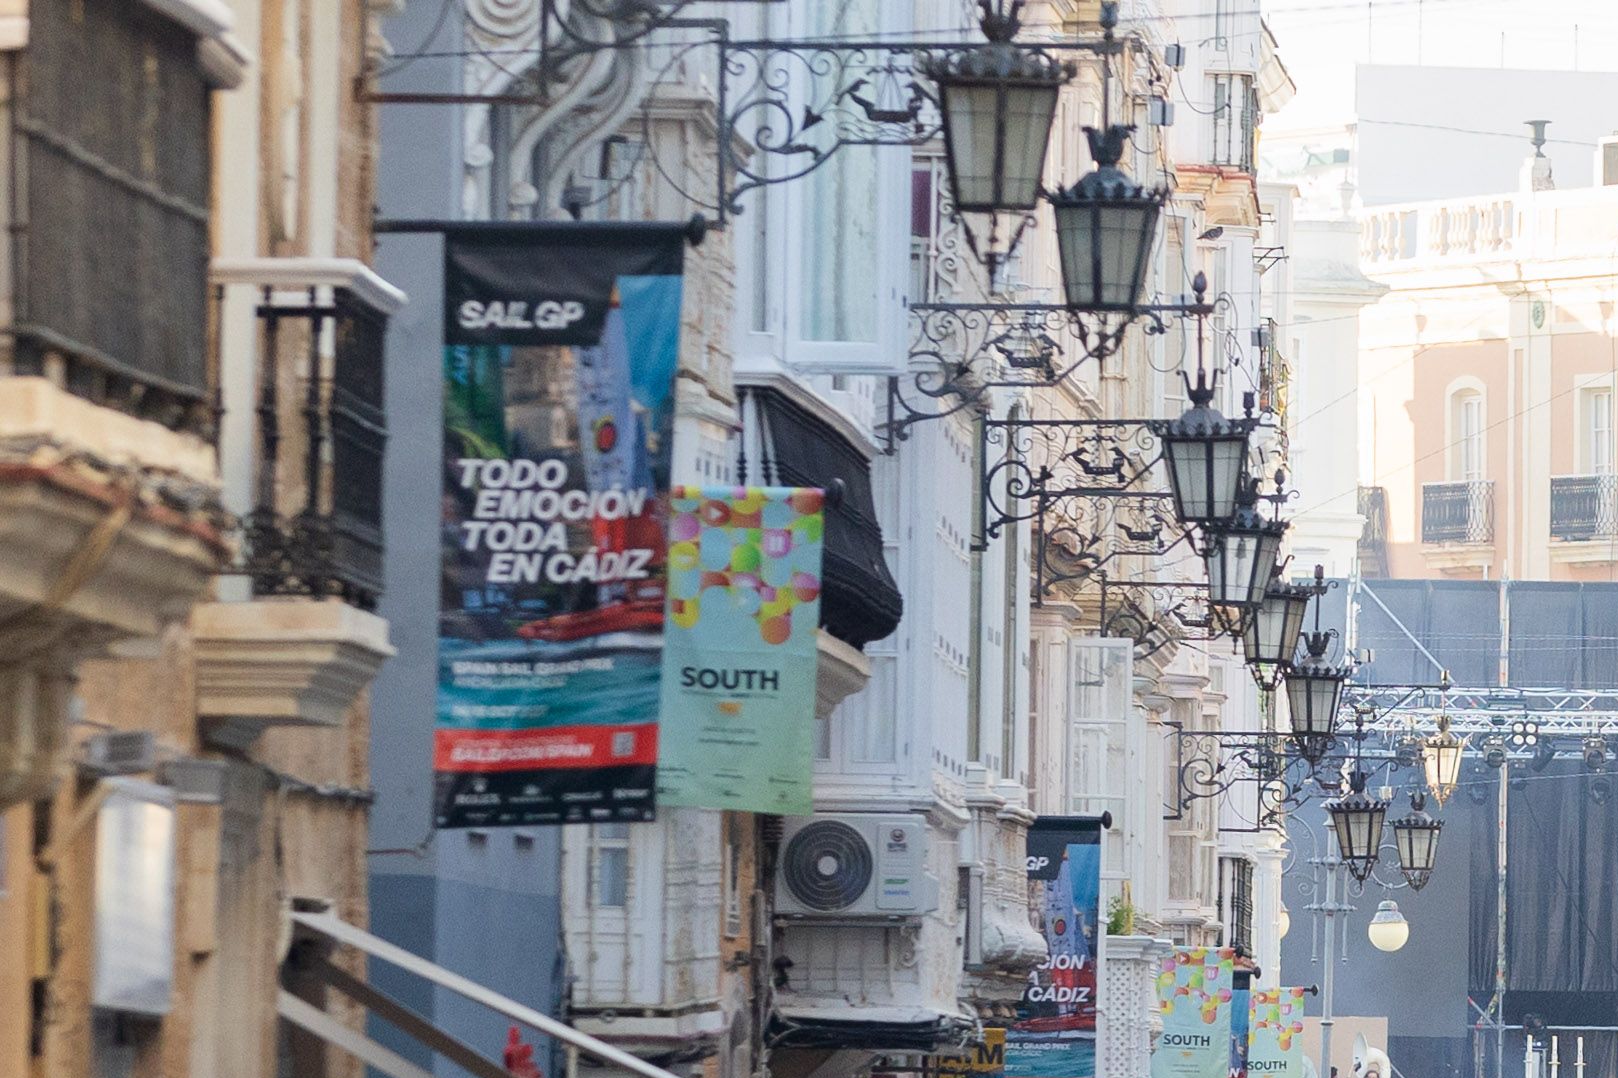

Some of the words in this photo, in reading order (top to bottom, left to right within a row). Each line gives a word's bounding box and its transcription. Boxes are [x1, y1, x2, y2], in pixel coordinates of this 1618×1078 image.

[457, 458, 568, 489] TODO
[474, 483, 648, 520] EMOCIÓN
[461, 520, 569, 551] TODA
[487, 552, 544, 583] EN
[545, 546, 654, 584] CÁDIZ
[680, 666, 780, 691] SOUTH
[1027, 982, 1091, 1003] CÁDIZ
[1163, 1034, 1210, 1047] SOUTH
[1247, 1060, 1287, 1071] SOUTH
